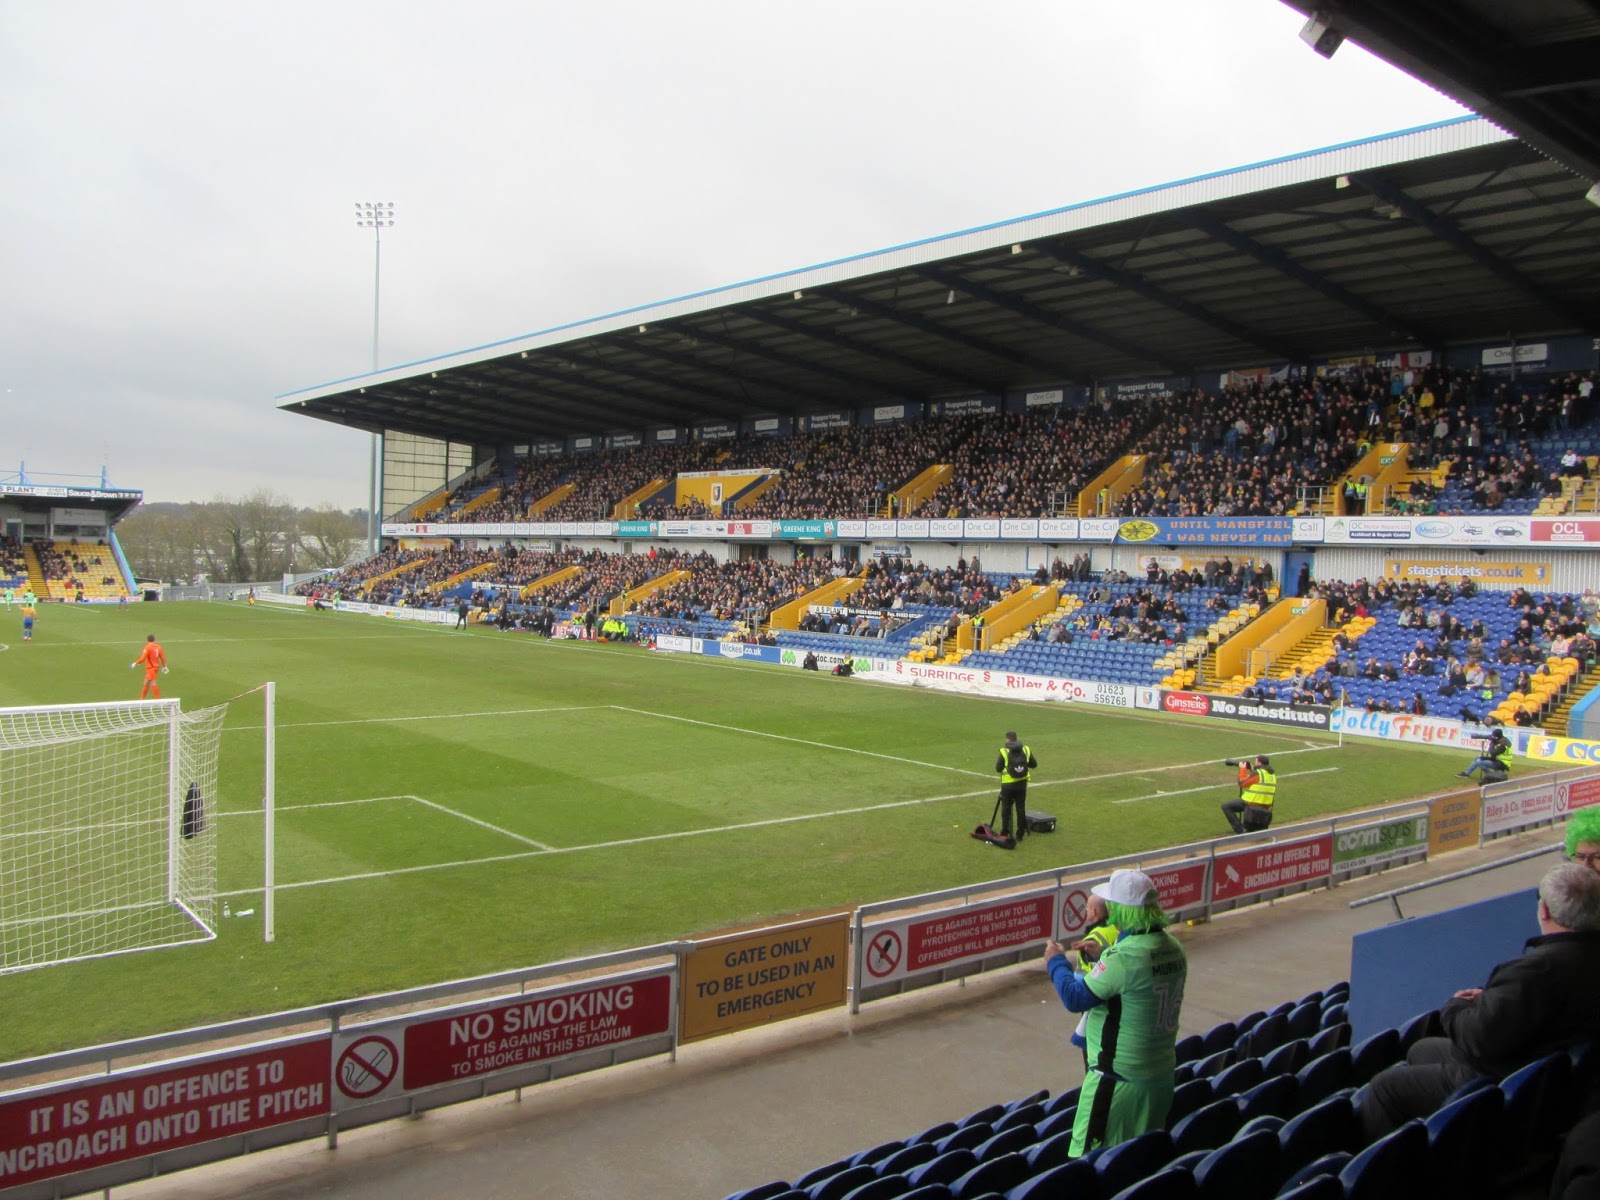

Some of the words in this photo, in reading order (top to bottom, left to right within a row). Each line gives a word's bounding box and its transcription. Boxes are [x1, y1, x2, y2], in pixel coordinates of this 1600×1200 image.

[1118, 382, 1164, 392] Supporting
[824, 521, 834, 532] IPA
[1170, 520, 1211, 529] UNTIL
[1216, 520, 1291, 529] MANSFIEL
[1300, 522, 1318, 532] Call
[1552, 522, 1583, 534] OCL
[1210, 534, 1257, 542] NEVER
[1408, 564, 1524, 578] stagstickets.co.uk
[1046, 680, 1057, 691] &
[1097, 684, 1124, 696] 01623
[1094, 694, 1127, 706] 556768
[1212, 700, 1236, 714] No
[1238, 704, 1326, 724] substitute
[1332, 709, 1390, 736] Jolly
[1392, 716, 1457, 742] Fryer
[1257, 855, 1264, 869] IT
[1264, 854, 1272, 868] IS
[1273, 852, 1283, 865] AN
[1284, 846, 1311, 863] OFFENCE
[1312, 844, 1320, 857] TO
[1152, 873, 1179, 888] OKING
[1244, 869, 1280, 889] ENCROACH
[1281, 865, 1297, 880] ONTO
[1299, 862, 1311, 875] THE
[1312, 858, 1330, 873] PITCH
[926, 925, 934, 935] IT
[935, 923, 943, 933] IS
[945, 917, 978, 931] AGAINST
[979, 913, 994, 923] THE
[994, 909, 1011, 920] LAW
[1013, 907, 1022, 916] TO
[1024, 903, 1037, 914] USE
[918, 945, 963, 964] OFFENDERS
[965, 940, 983, 951] WILL
[985, 937, 994, 947] BE
[995, 926, 1041, 944] PROSECUTED
[922, 927, 980, 948] PYROTECHNICS
[982, 924, 989, 934] IN
[991, 921, 1006, 932] THIS
[724, 946, 766, 968] GATE
[770, 936, 812, 958] ONLY
[696, 980, 719, 998] TO
[724, 974, 744, 992] BE
[748, 965, 790, 987] USED
[794, 960, 809, 977] IN
[813, 955, 835, 972] AN
[1152, 959, 1185, 977] MURRA
[717, 982, 816, 1018] EMERGENCY
[450, 1014, 494, 1046] NO
[504, 985, 634, 1033] SMOKING
[467, 1045, 482, 1058] IT
[484, 1041, 496, 1054] IS
[500, 1028, 558, 1051] AGAINST
[562, 1023, 587, 1036] THE
[590, 1015, 618, 1031] LAW
[452, 1063, 471, 1076] TO
[475, 1049, 523, 1071] SMOKE
[527, 1045, 541, 1058] IN
[545, 1038, 573, 1054] THIS
[577, 1025, 631, 1047] STADIUM
[30, 1109, 54, 1135] IT
[63, 1100, 89, 1128] IS
[98, 1089, 134, 1120] AN
[143, 1067, 248, 1110] OFFENCE
[256, 1060, 284, 1086] TO
[136, 1109, 200, 1145] ONTO
[208, 1098, 250, 1128] THE
[258, 1083, 323, 1118] PITCH
